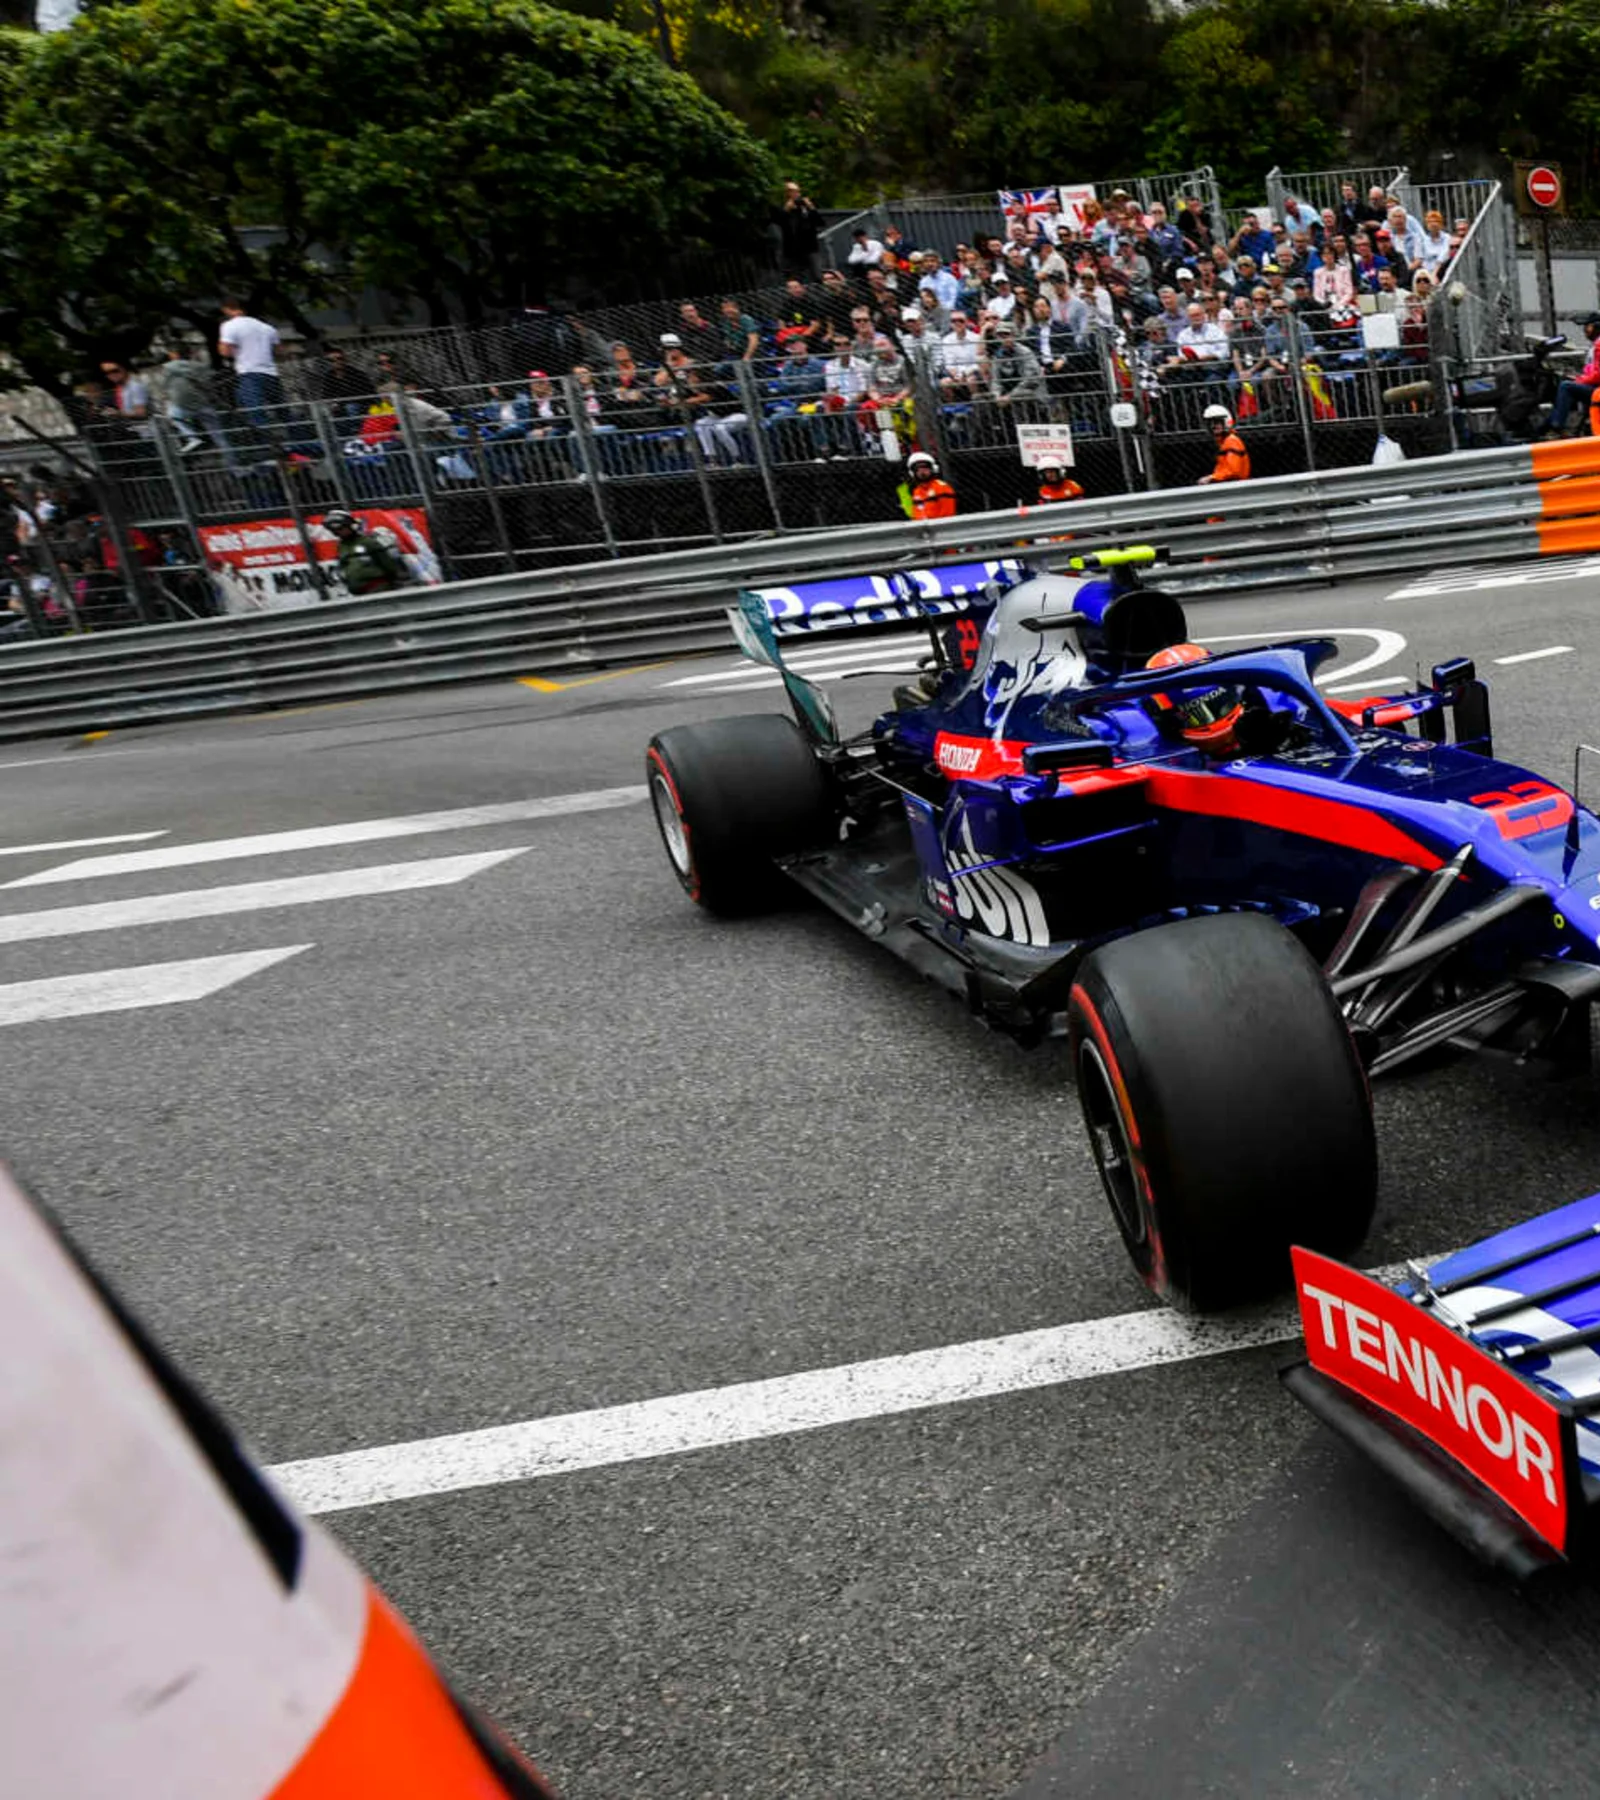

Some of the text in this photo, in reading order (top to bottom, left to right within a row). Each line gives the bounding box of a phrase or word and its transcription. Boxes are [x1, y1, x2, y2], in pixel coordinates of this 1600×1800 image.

[749, 574, 894, 636] Red
[940, 743, 983, 772] HONDA
[1302, 1284, 1559, 1507] TENNOR
